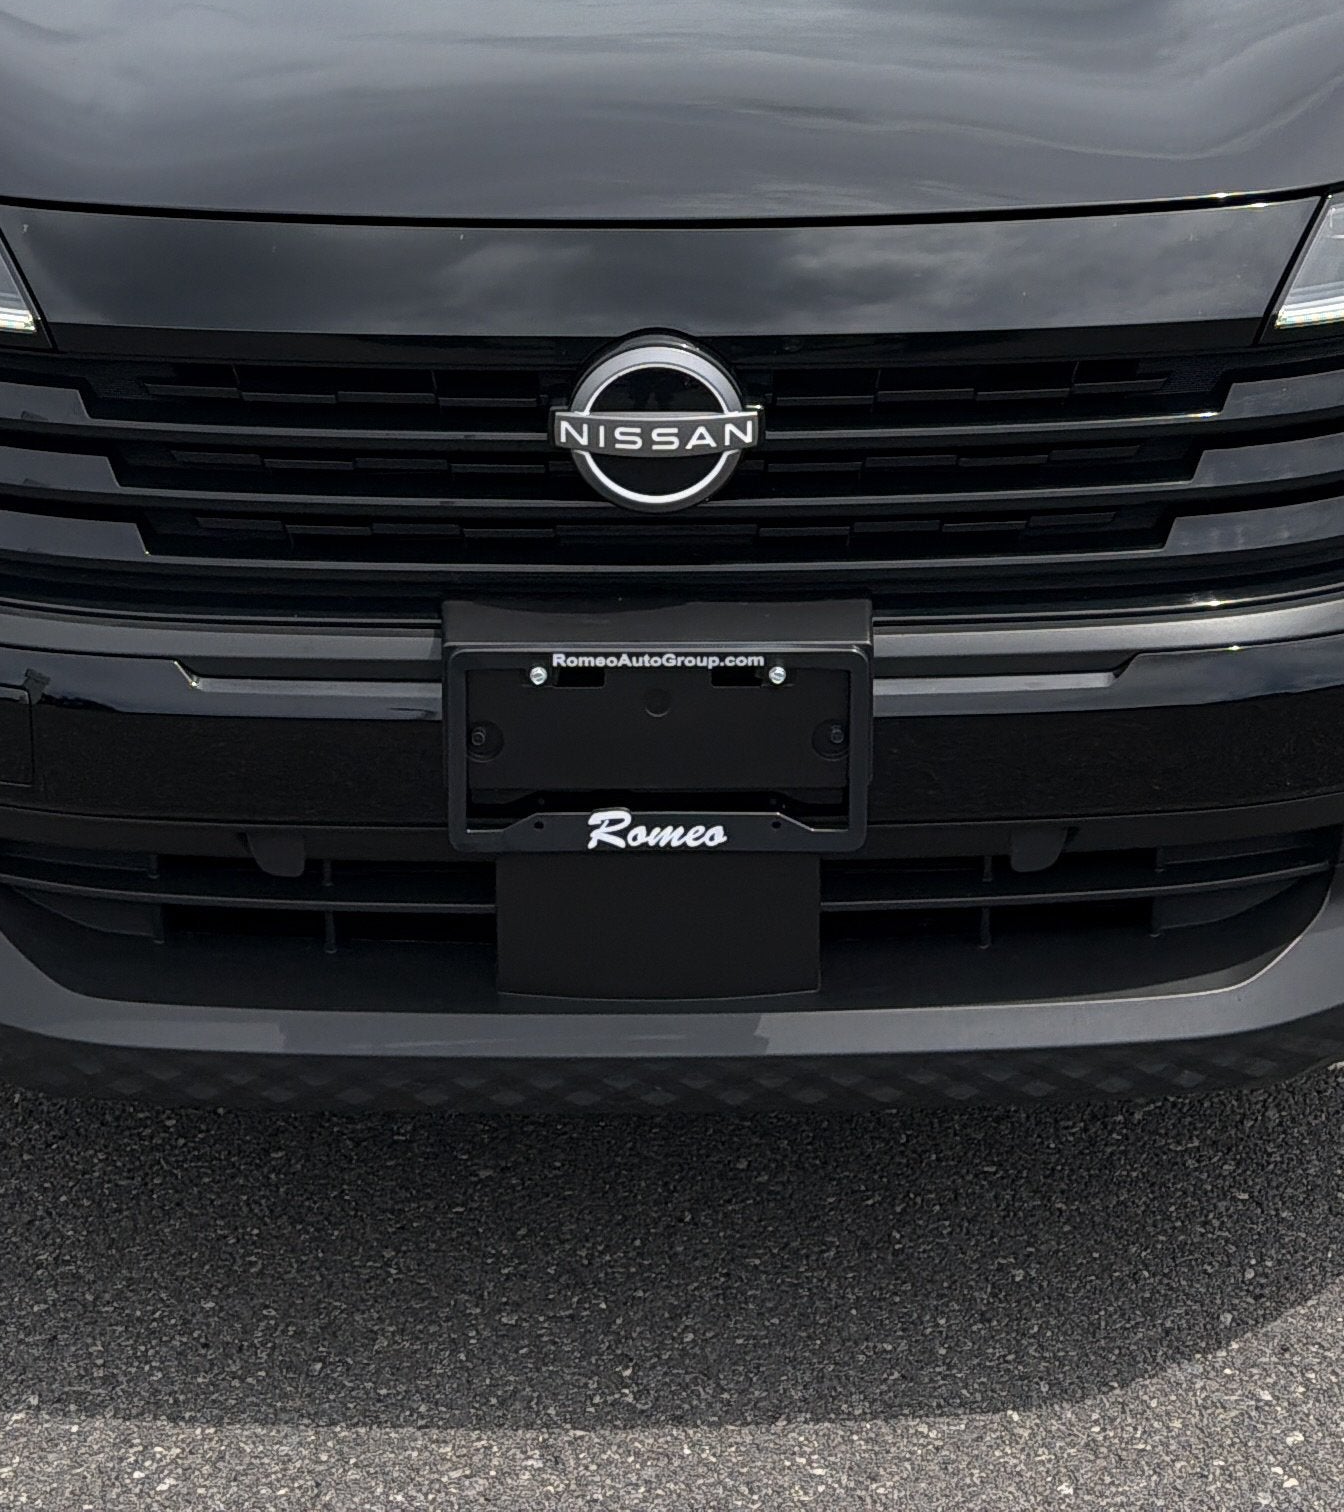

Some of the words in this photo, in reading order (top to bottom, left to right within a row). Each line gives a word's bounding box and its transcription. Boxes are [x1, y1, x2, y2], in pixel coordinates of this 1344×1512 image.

[560, 420, 753, 450] NISSAN
[552, 653, 765, 669] RomeoAutoGroup.com
[587, 810, 728, 849] Romeo
